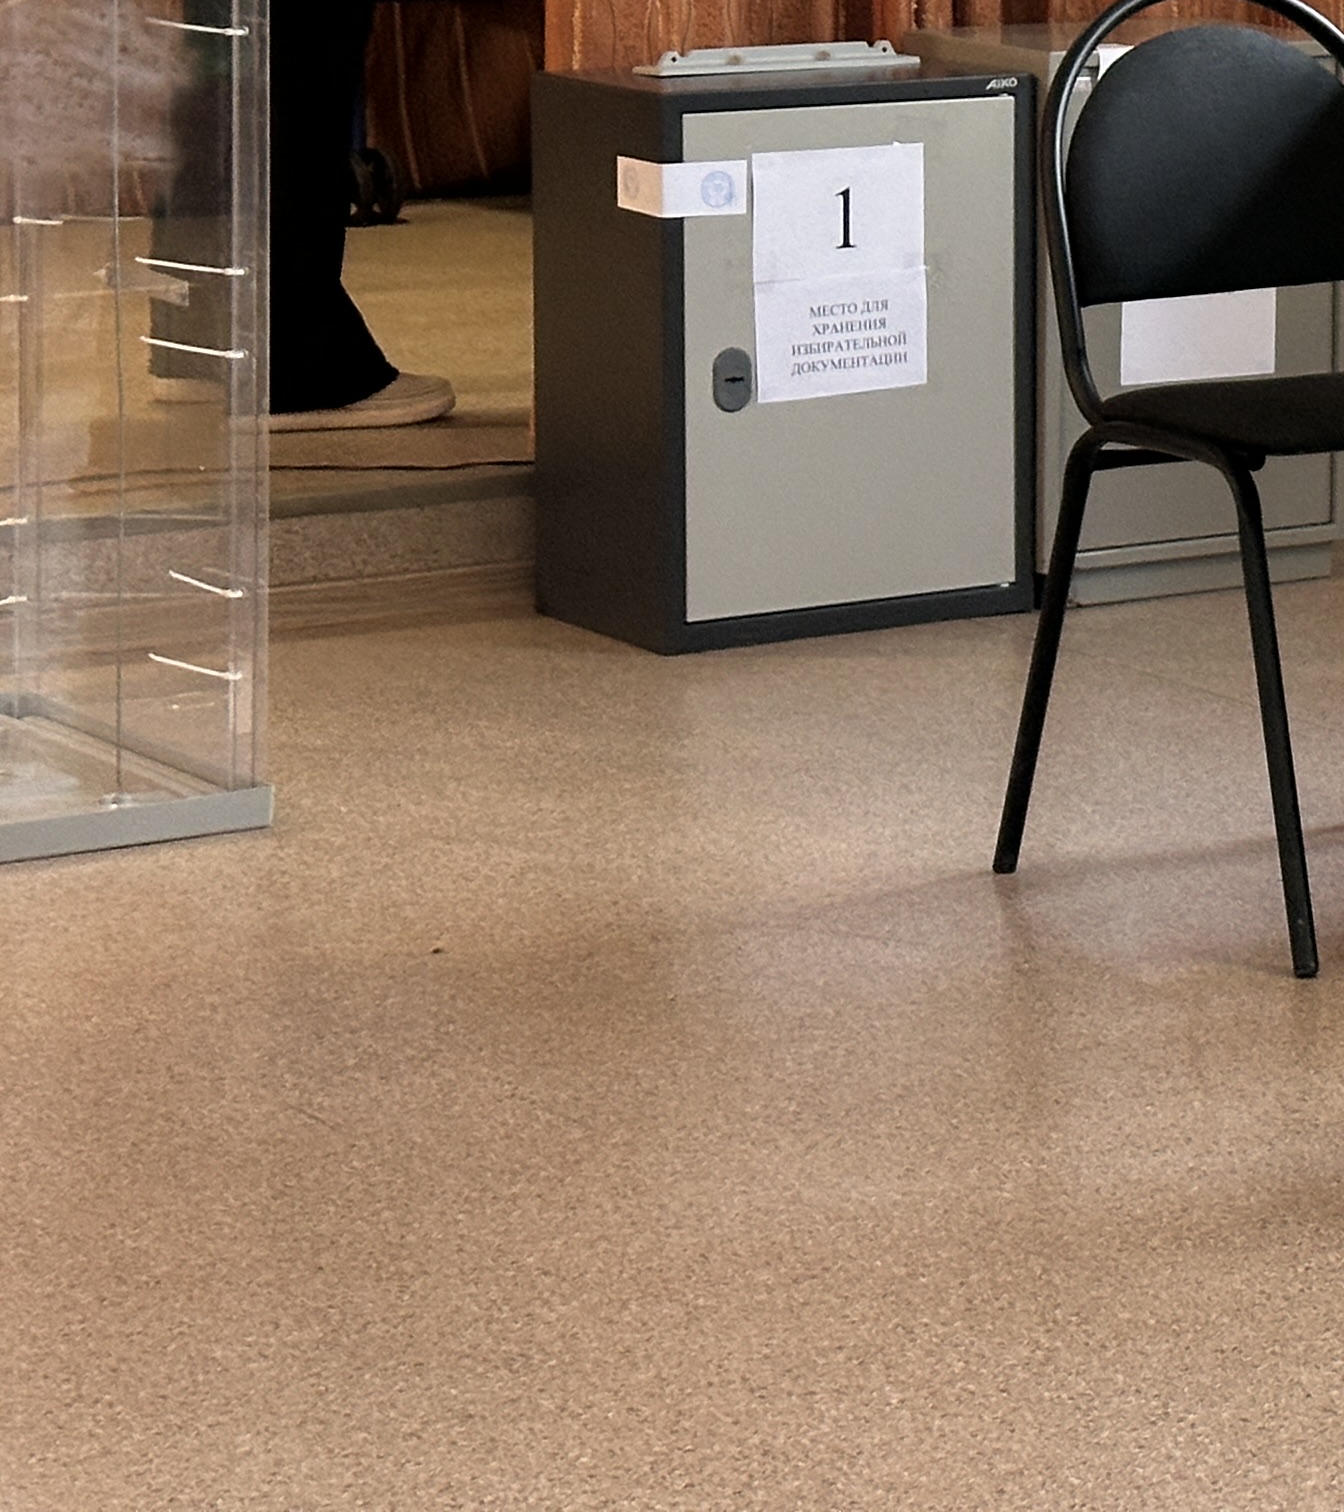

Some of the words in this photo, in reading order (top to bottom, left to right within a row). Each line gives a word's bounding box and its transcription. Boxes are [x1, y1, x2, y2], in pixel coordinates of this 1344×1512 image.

[985, 77, 1018, 90] AIKO
[835, 186, 857, 249] 1
[809, 301, 858, 319] МЕСТО
[861, 299, 889, 316] ДЛЯ
[812, 317, 887, 336] ХРАНЕНИЯ
[791, 331, 908, 356] ИЗБИРАТЕЛЬНОЙ
[791, 351, 909, 376] ДОКУМЕНТАЦИИ
